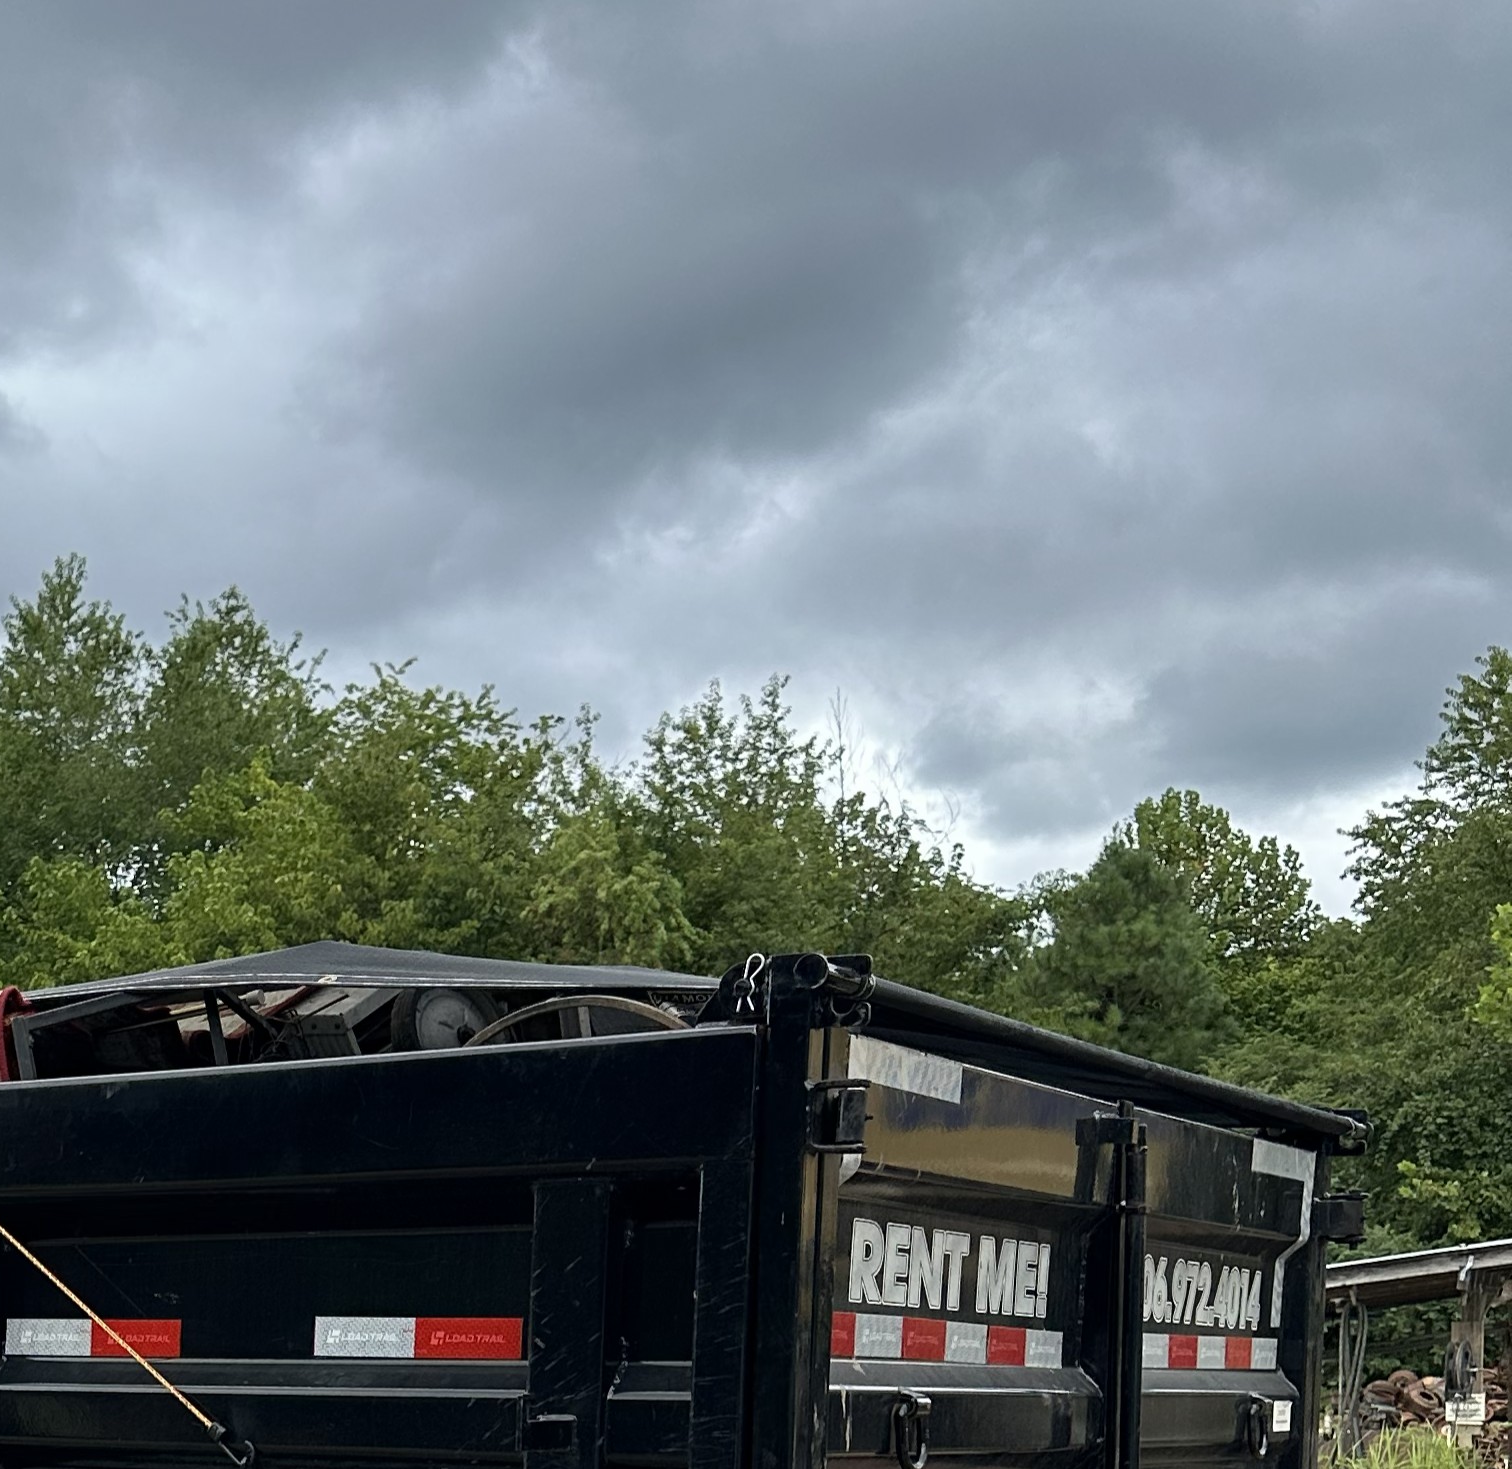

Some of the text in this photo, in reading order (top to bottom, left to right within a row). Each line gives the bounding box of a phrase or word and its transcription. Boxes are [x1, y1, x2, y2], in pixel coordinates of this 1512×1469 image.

[848, 1217, 1051, 1319] RENT ME!
[1143, 1254, 1262, 1331] 06.972.4014
